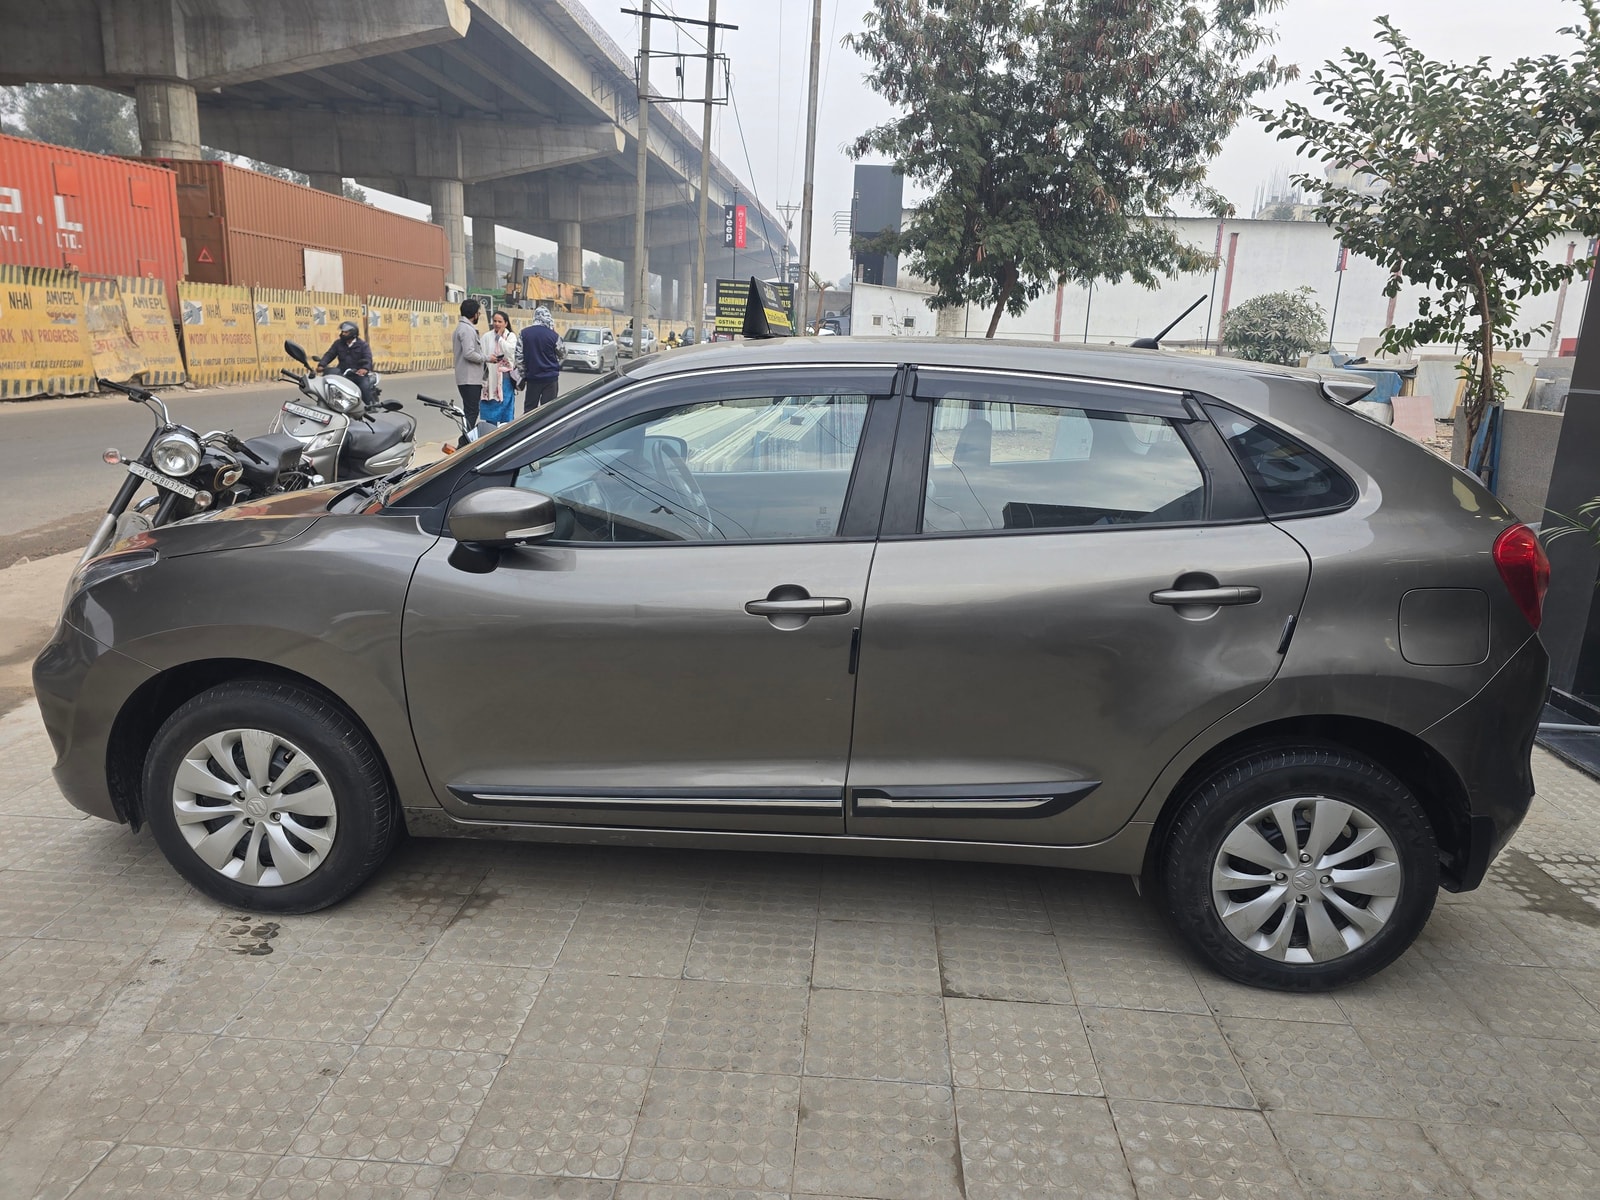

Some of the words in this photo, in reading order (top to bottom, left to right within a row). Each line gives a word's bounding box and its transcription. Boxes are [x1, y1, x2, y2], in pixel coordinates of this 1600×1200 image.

[56, 232, 82, 249] LTD.
[9, 291, 32, 310] NHAI
[46, 291, 79, 306] AMVEPL
[133, 296, 166, 310] AMVEPL
[206, 304, 222, 318] NHAI
[273, 307, 286, 320] NHAI
[295, 306, 312, 318] AMVEPL
[329, 309, 339, 321] NHAI
[22, 329, 34, 343] IN
[39, 329, 80, 343] PROGRESS
[189, 333, 207, 344] WORK
[211, 334, 218, 344] IN
[222, 334, 252, 344] PROGRESS
